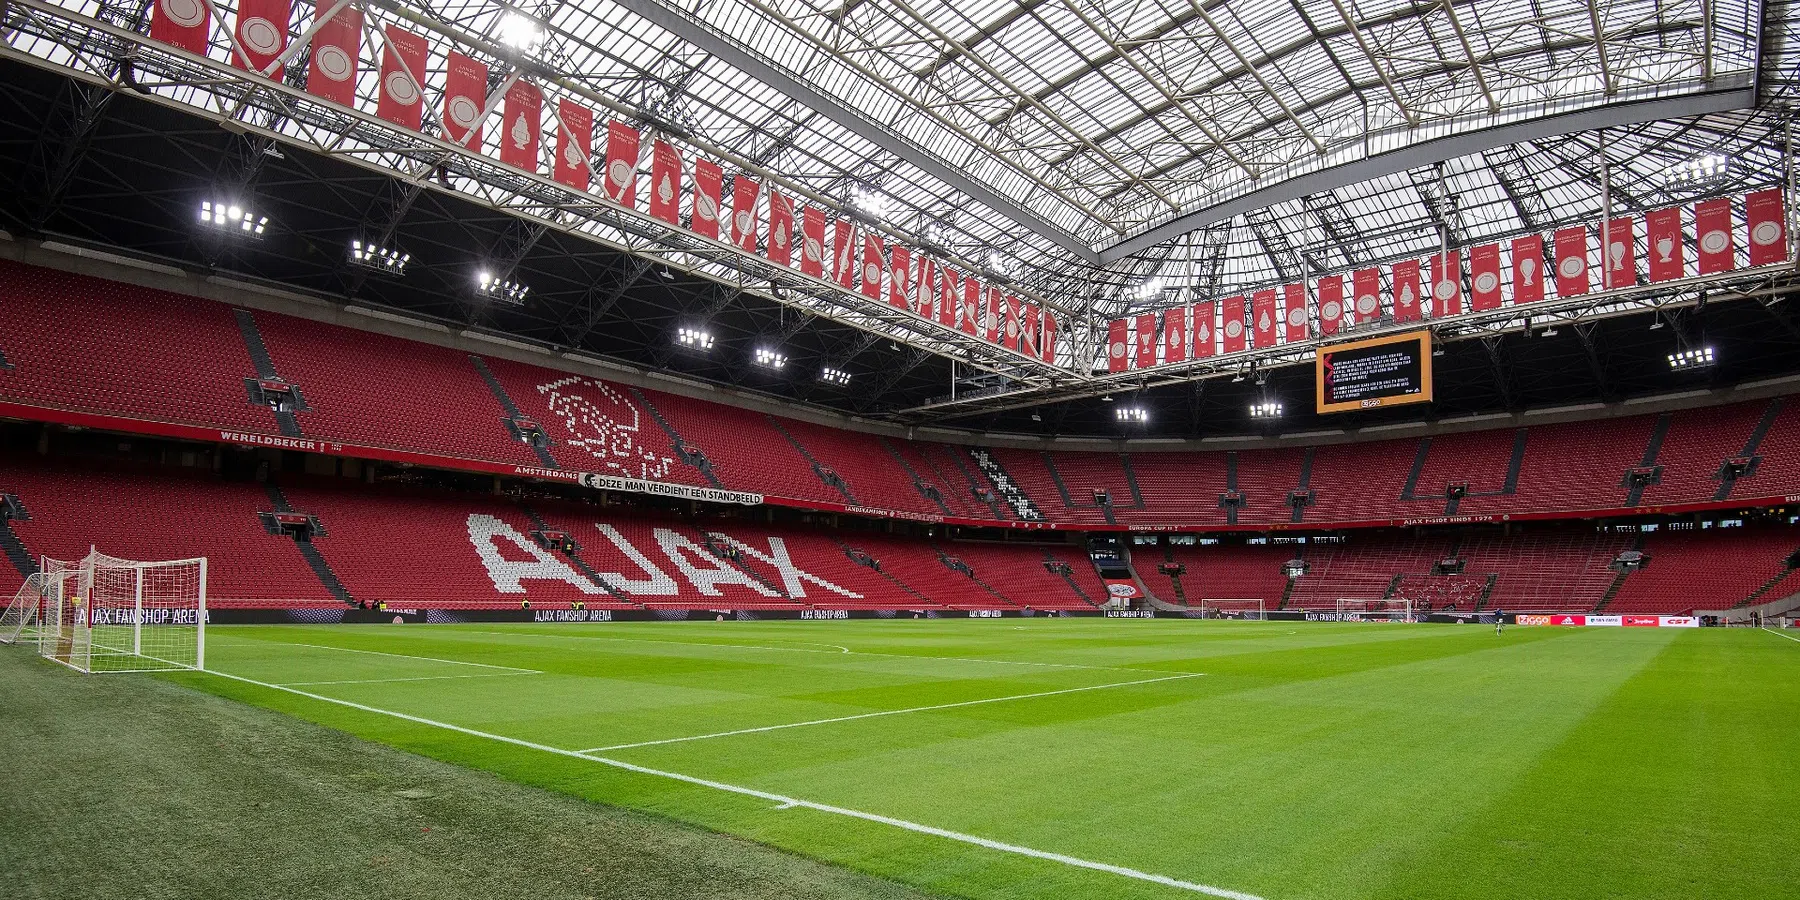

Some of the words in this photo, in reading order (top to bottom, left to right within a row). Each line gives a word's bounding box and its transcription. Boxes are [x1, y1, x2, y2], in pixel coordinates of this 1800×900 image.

[220, 431, 315, 450] WERELDBEKER
[514, 466, 578, 480] AMSTERDAMS
[599, 478, 622, 490] DEZE
[625, 481, 646, 491] MAN
[647, 483, 690, 497] VERDIENT
[690, 488, 707, 499] EEN
[708, 491, 761, 504] STANDBEELD
[467, 514, 863, 599] AJAX
[115, 608, 170, 624] FANSHOP
[535, 609, 555, 622] AJAX
[556, 609, 588, 622] FANSHOP
[590, 609, 612, 622] ARENA
